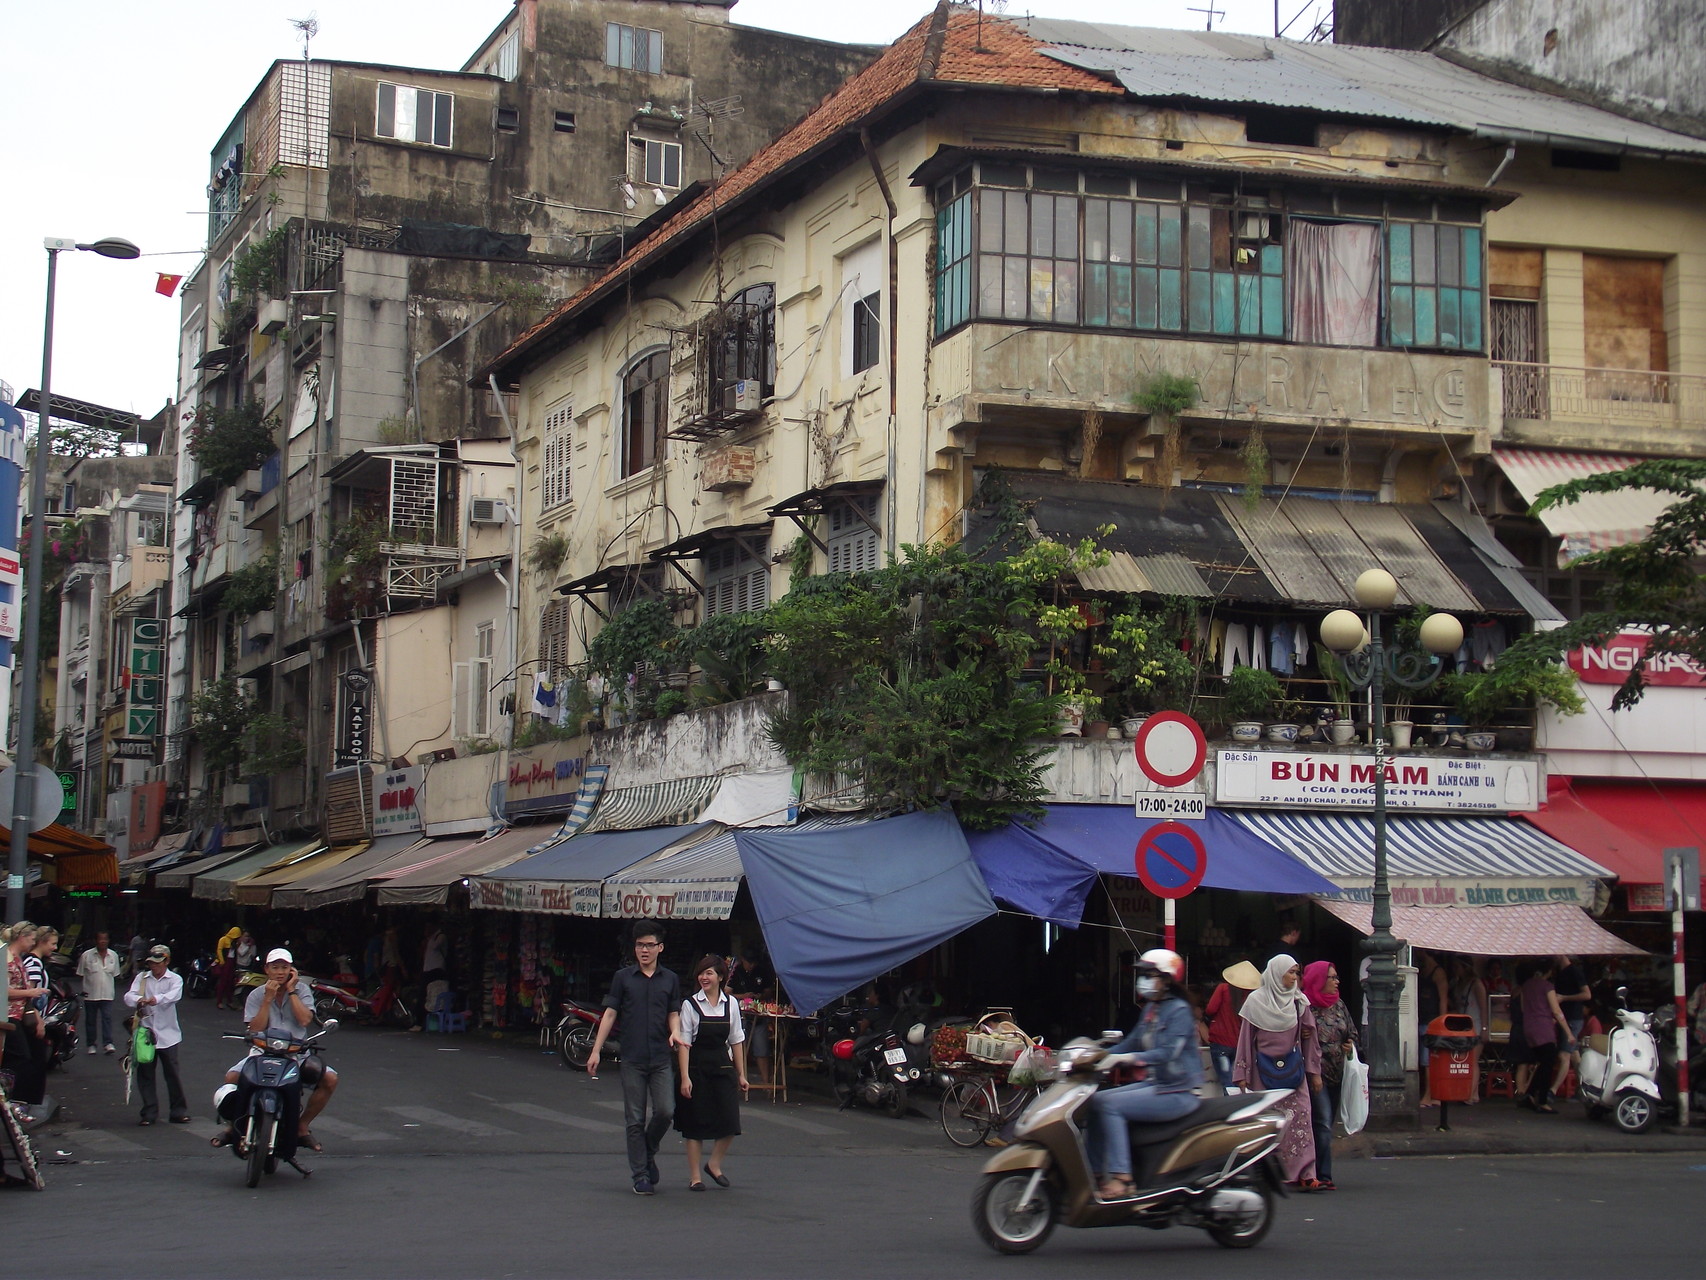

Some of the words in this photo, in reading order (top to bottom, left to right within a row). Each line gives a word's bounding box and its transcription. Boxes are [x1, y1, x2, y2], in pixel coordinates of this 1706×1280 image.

[351, 706, 363, 755] TATTOO
[120, 743, 154, 755] HOTEL
[1271, 758, 1339, 782] BÚN
[1350, 757, 1429, 785] MẮM
[1437, 773, 1458, 786] BÁNH
[1459, 776, 1480, 787] CANH
[624, 889, 652, 914] CÚC
[1391, 882, 1419, 904] BÚN
[1465, 883, 1505, 904] BÁNH
[1507, 887, 1547, 903] CANH
[1548, 887, 1580, 901] CUA
